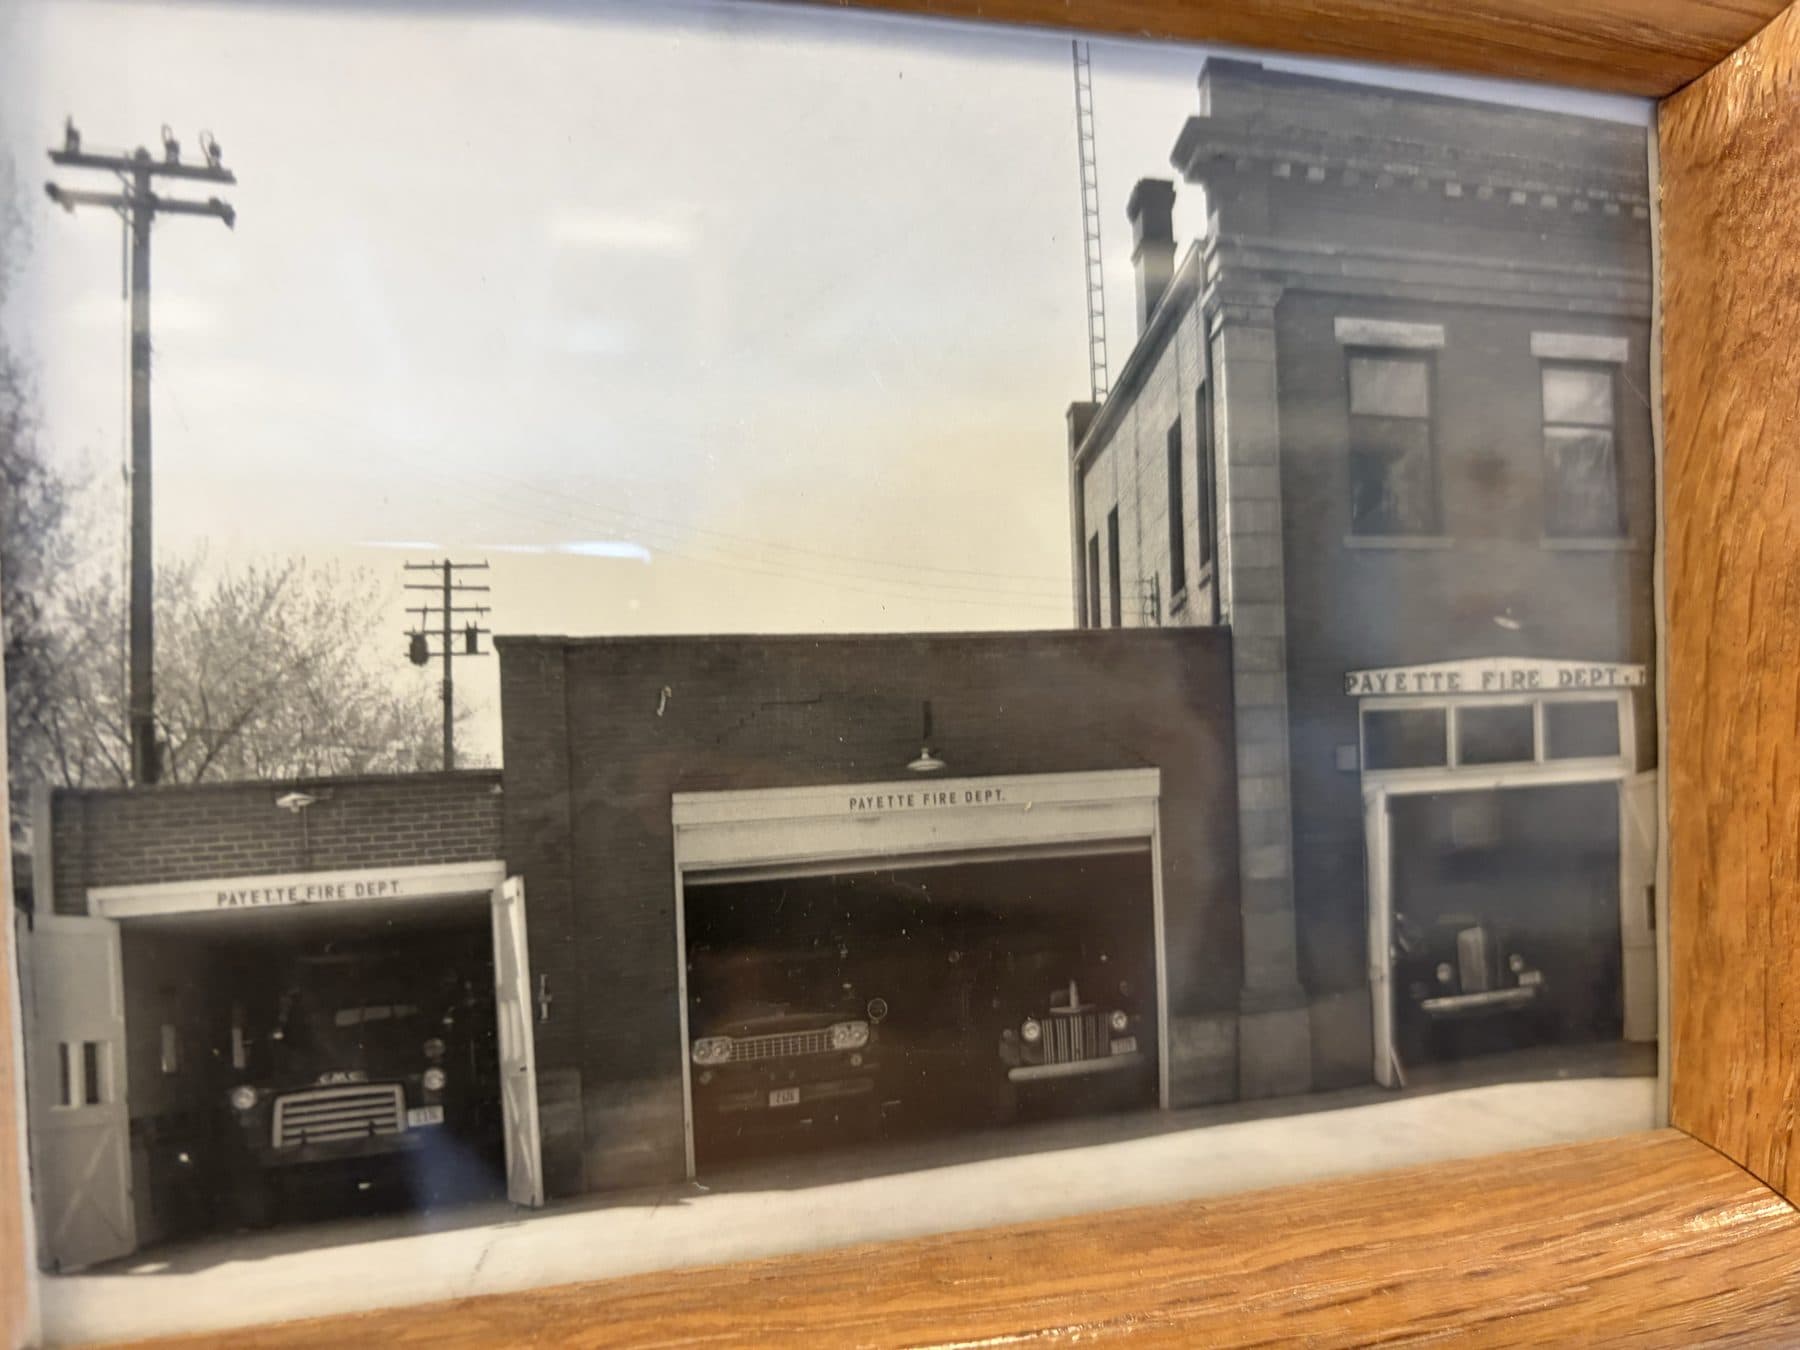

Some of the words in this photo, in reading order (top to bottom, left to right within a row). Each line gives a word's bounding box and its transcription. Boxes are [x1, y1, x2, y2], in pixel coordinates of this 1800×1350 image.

[1345, 671, 1460, 693] PAYETTE
[1481, 669, 1539, 690] FIRE
[850, 794, 914, 810] PAYETTE
[923, 791, 957, 806] FIRE
[217, 887, 297, 906] PAYETTE
[306, 884, 346, 899] FIRE
